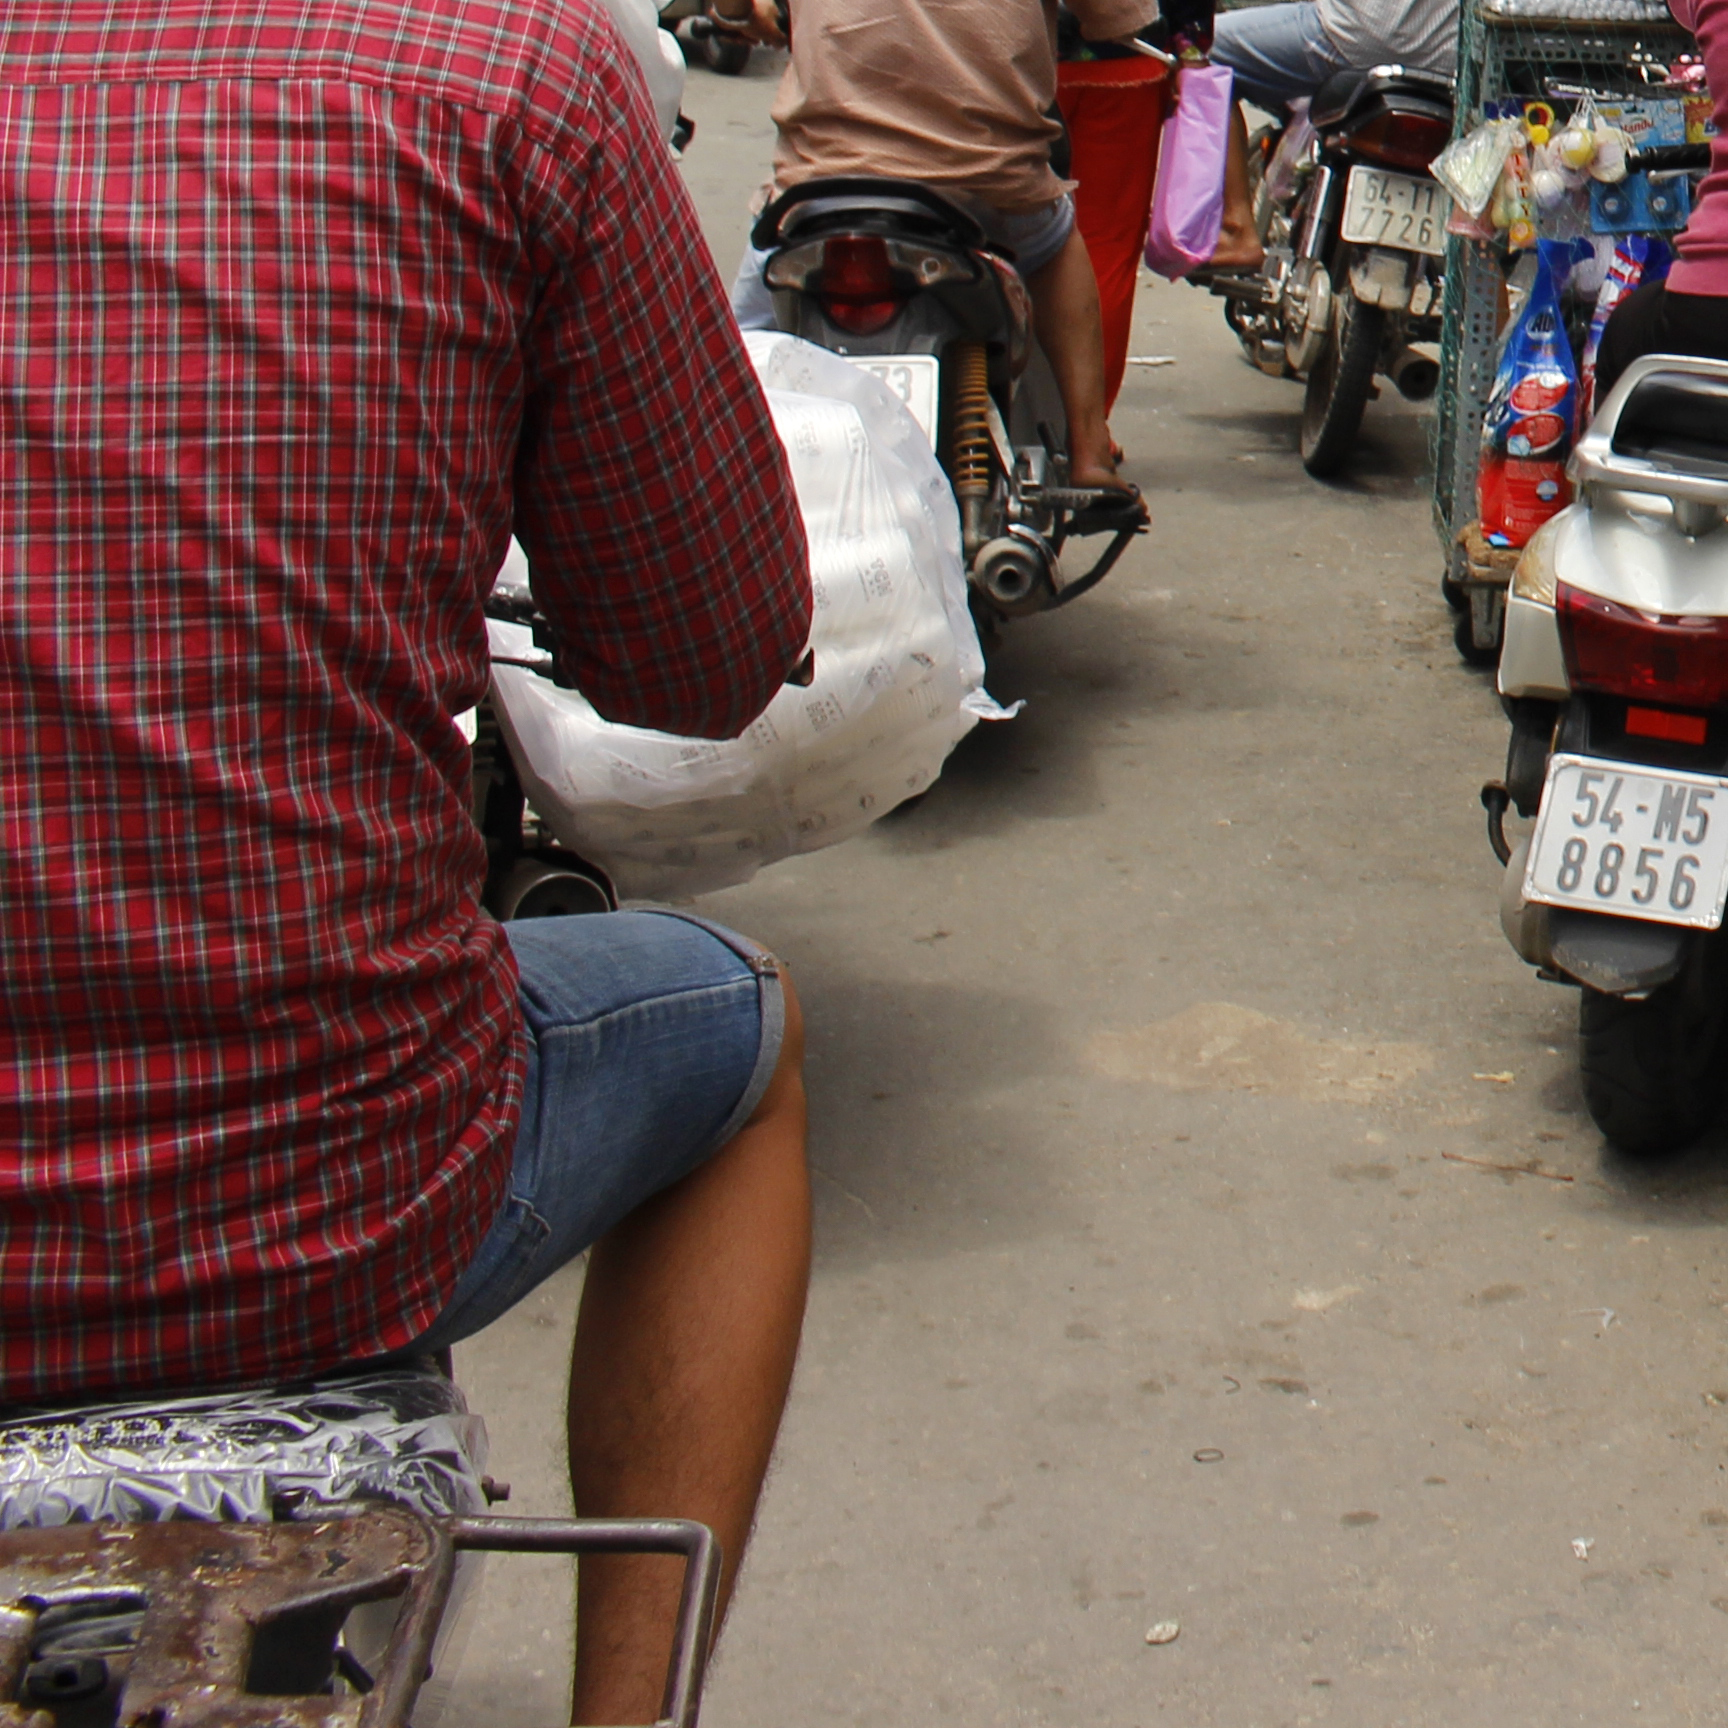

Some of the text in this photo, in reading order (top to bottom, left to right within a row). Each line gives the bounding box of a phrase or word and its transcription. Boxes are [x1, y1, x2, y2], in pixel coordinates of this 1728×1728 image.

[1360, 207, 1434, 246] 7726
[1571, 773, 1716, 845] 54-M5
[1557, 837, 1699, 910] 8856
